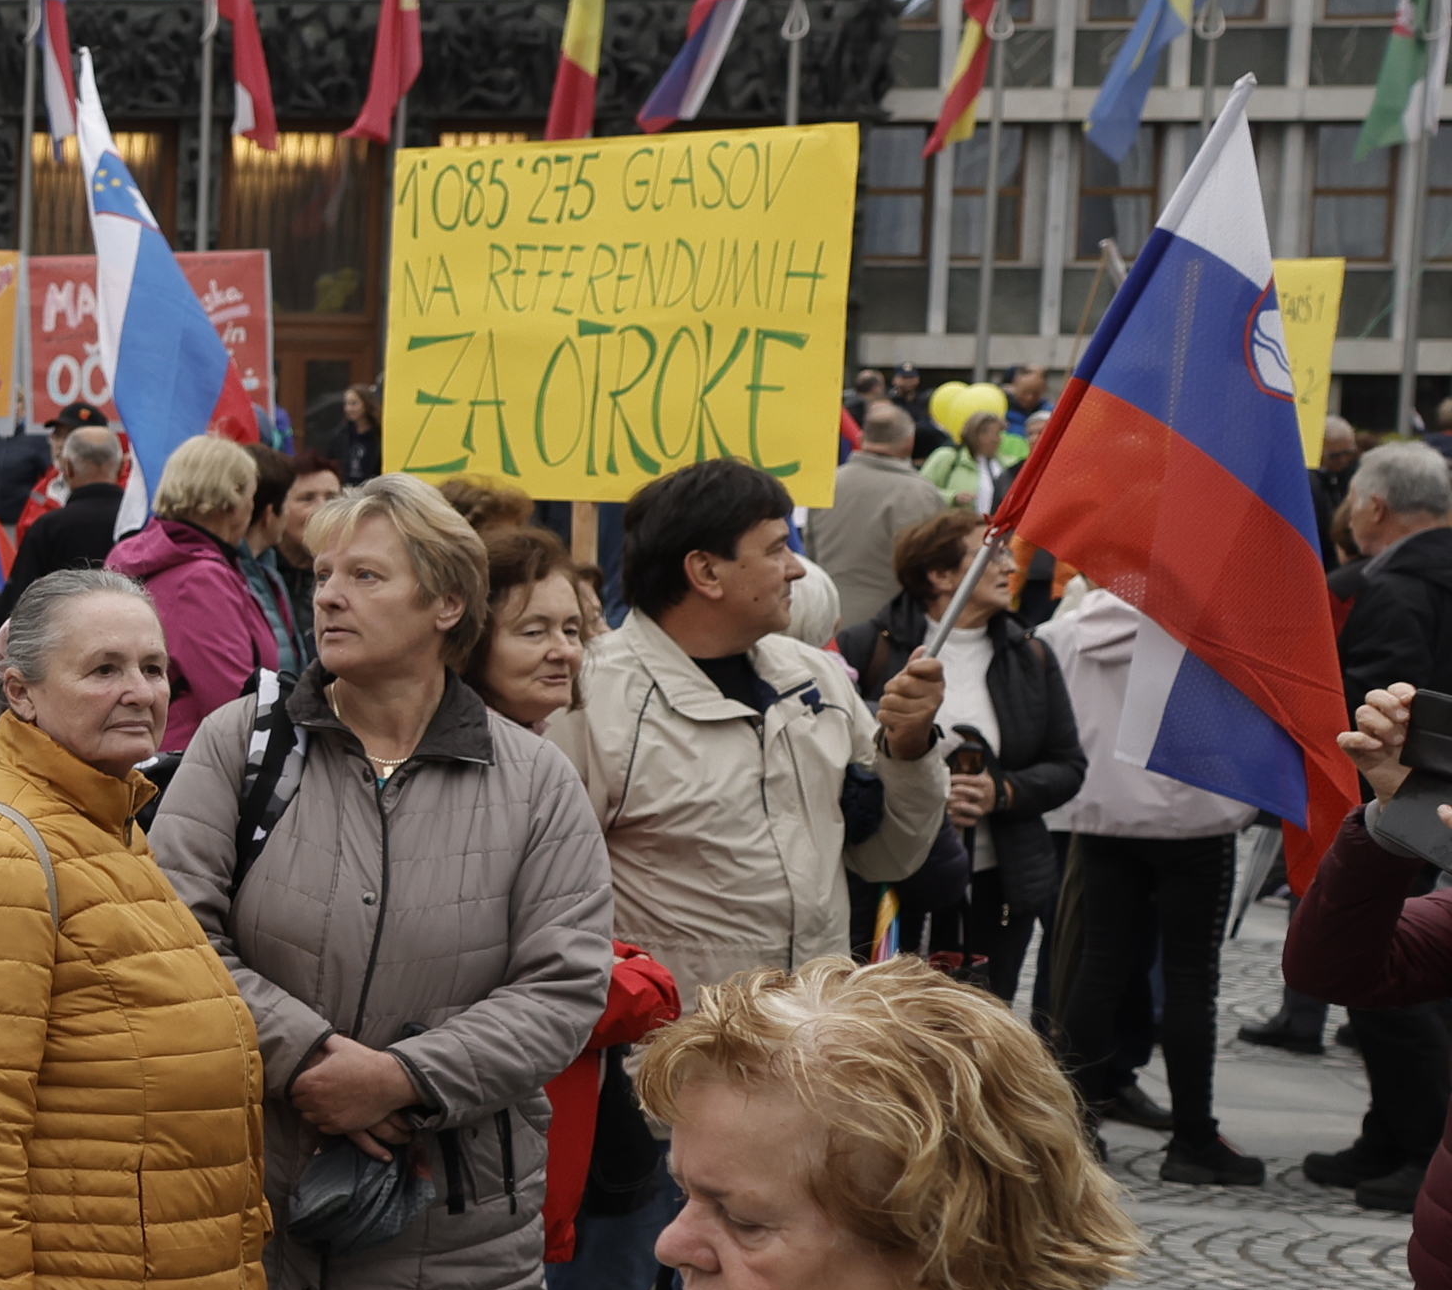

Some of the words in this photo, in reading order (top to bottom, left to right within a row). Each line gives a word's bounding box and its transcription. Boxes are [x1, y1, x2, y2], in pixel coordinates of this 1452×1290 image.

[622, 138, 803, 212] GLASOV
[404, 254, 460, 318] NA
[483, 237, 827, 316] REFERENDUMIH
[401, 329, 522, 477] ZA
[535, 318, 811, 477] OTROKE
